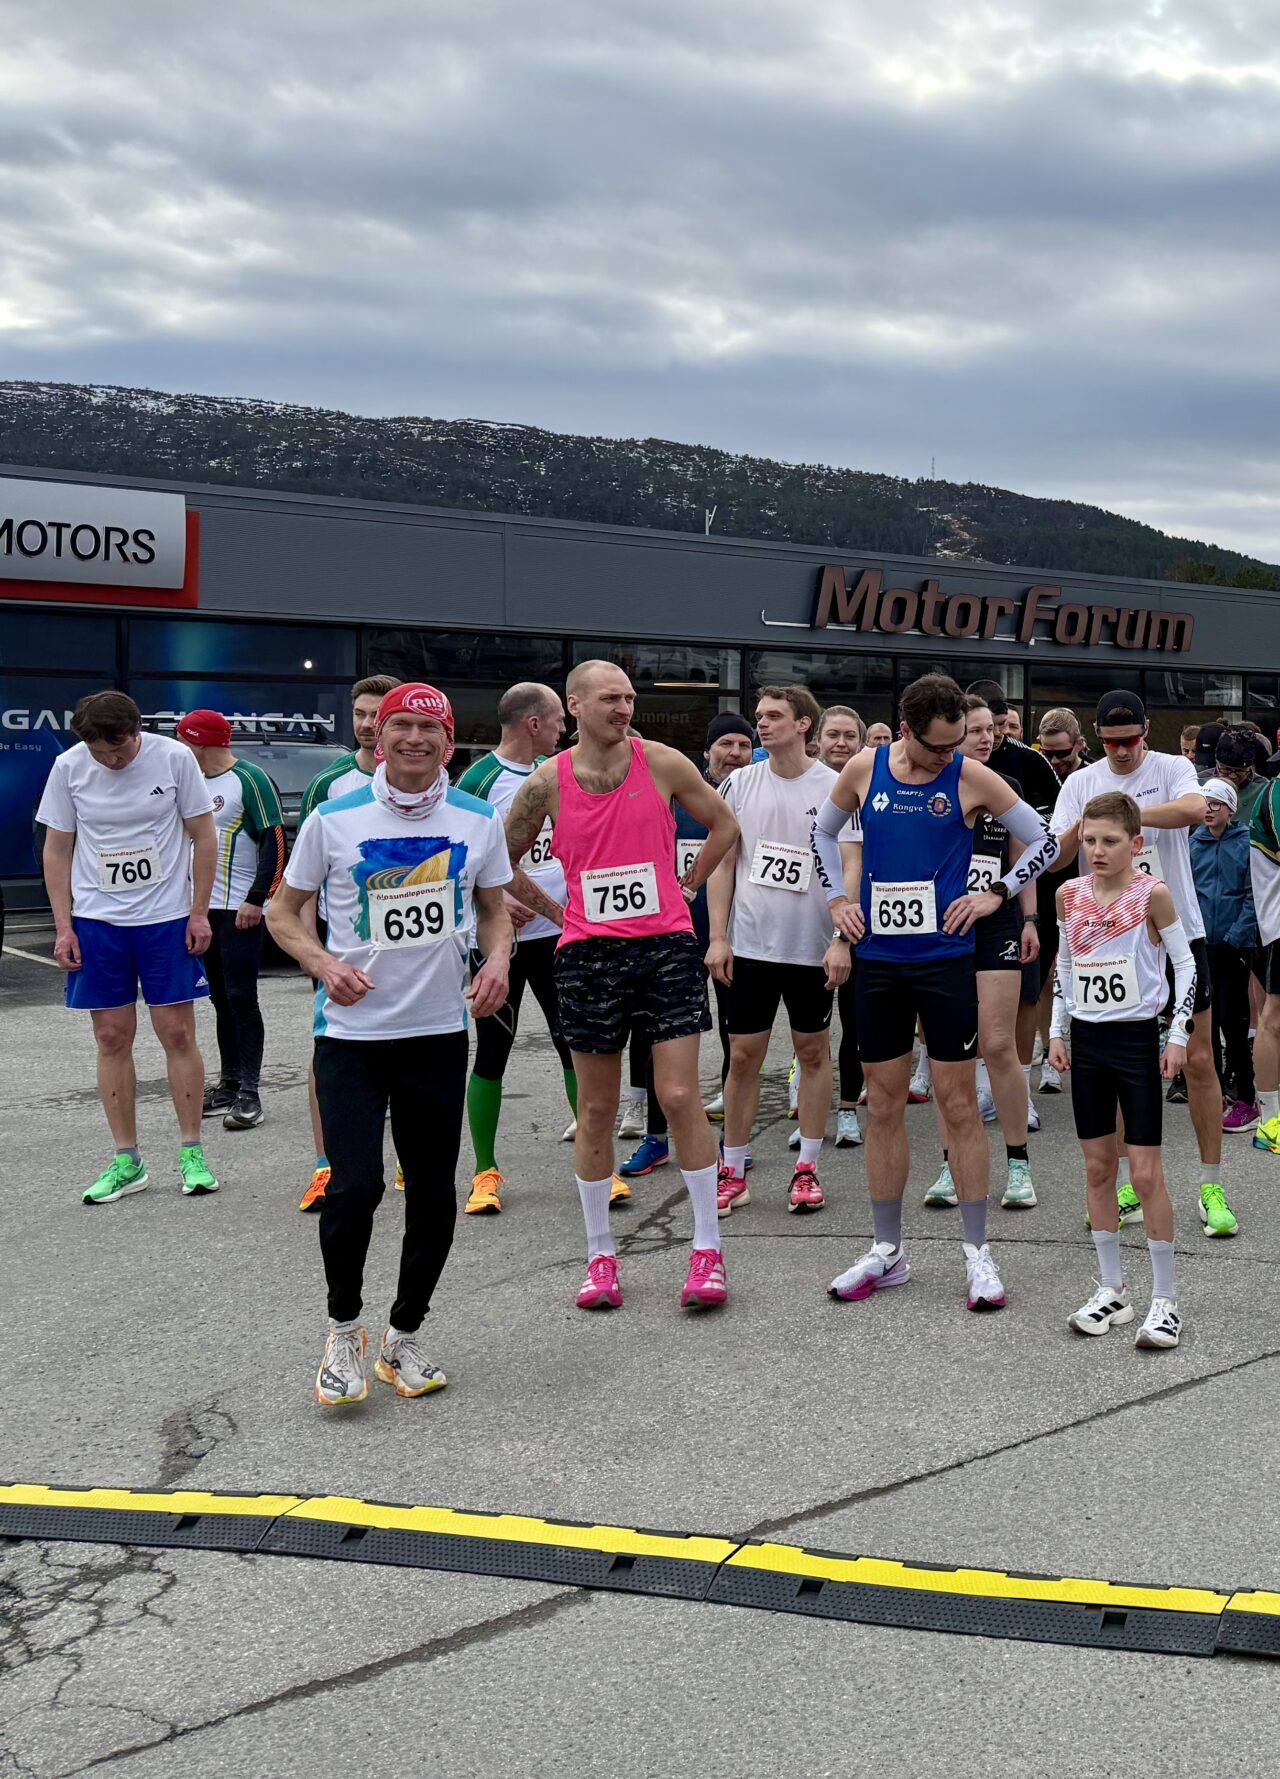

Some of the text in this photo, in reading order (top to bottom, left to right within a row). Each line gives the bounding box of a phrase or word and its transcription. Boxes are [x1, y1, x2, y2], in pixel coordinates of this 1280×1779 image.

[15, 742, 42, 751] Easy
[105, 858, 152, 885] 760
[760, 855, 801, 885] 735
[592, 881, 647, 914] 756
[384, 901, 444, 941] 639
[879, 899, 924, 928] 633
[1078, 973, 1126, 1004] 736
